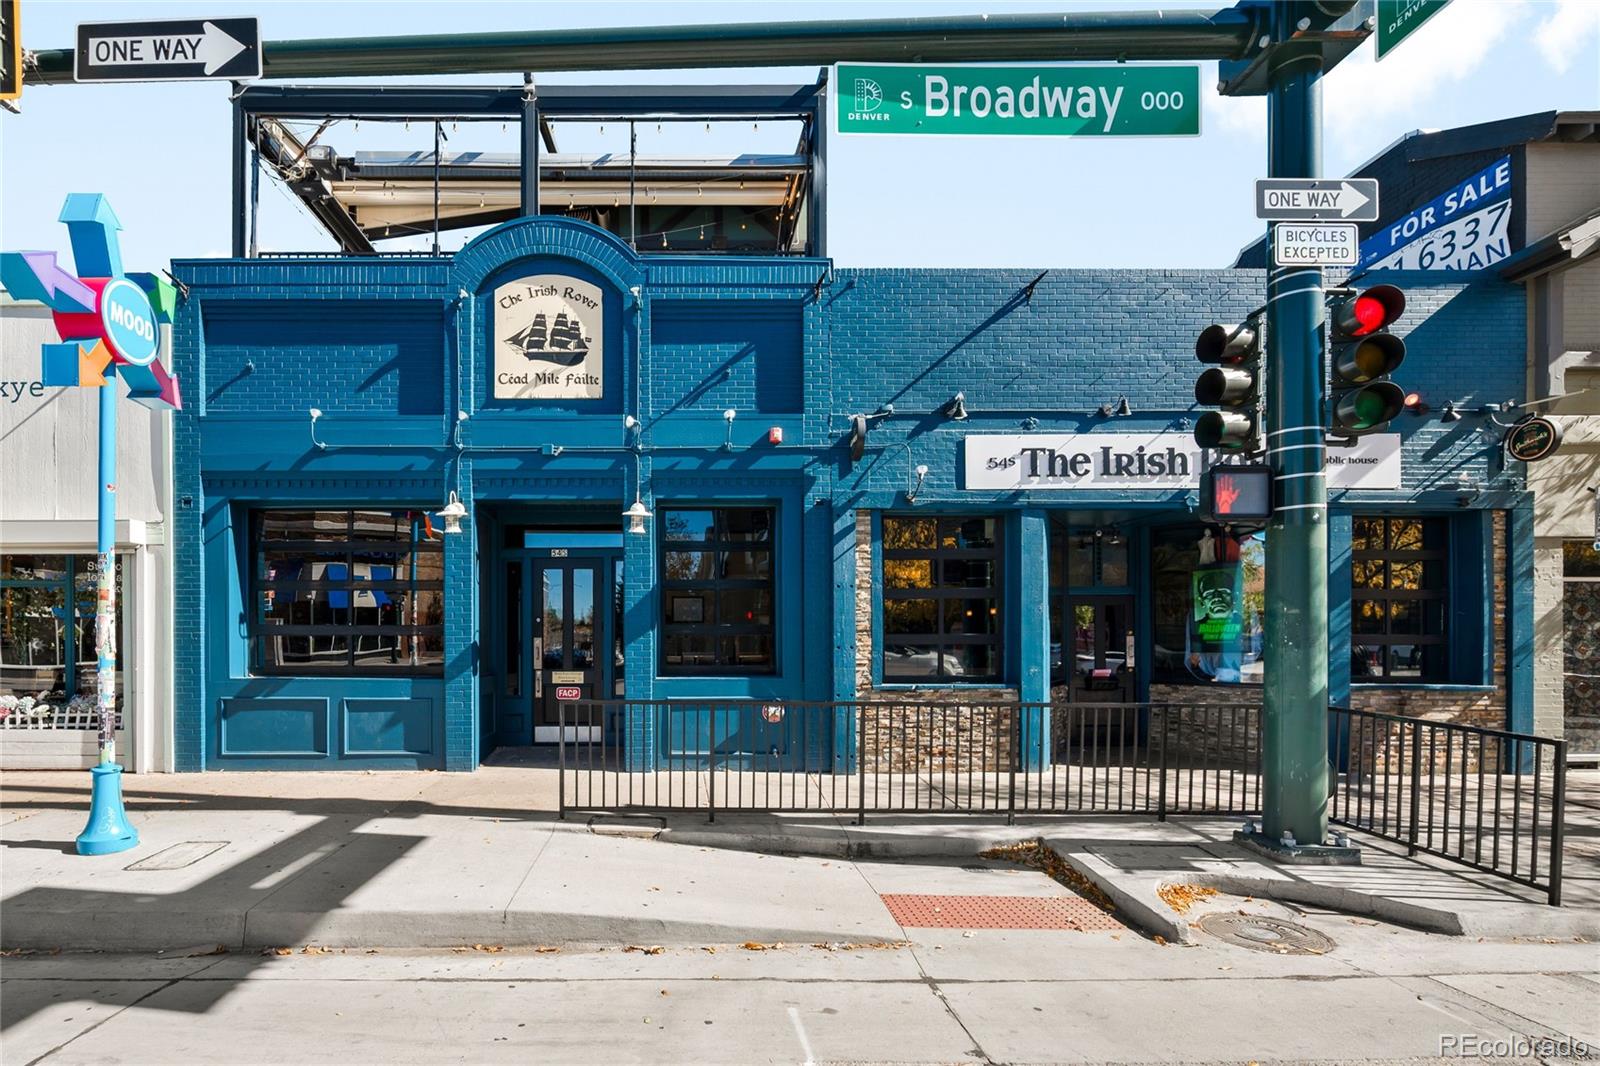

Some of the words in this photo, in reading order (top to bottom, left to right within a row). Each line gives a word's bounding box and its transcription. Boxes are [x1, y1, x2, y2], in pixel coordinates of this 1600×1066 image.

[1388, 0, 1428, 34] DENVE
[95, 40, 143, 62] ONE
[152, 38, 202, 61] WAY
[900, 91, 913, 109] S
[925, 75, 1124, 132] Broadway
[848, 112, 890, 121] DENVER
[1268, 192, 1301, 207] ONE
[1307, 192, 1340, 207] WAY
[1390, 206, 1436, 246] FOR
[1444, 162, 1510, 216] SALE
[1286, 230, 1347, 242] BICYCLES
[1418, 200, 1510, 270] 6337
[1284, 246, 1349, 258] EXCEPTED
[499, 293, 523, 309] The
[527, 285, 558, 299] Irish
[563, 286, 599, 310] Rover
[110, 301, 154, 341] MOOD
[1020, 447, 1091, 477] The
[1348, 456, 1379, 465] house
[558, 689, 578, 697] FACP
